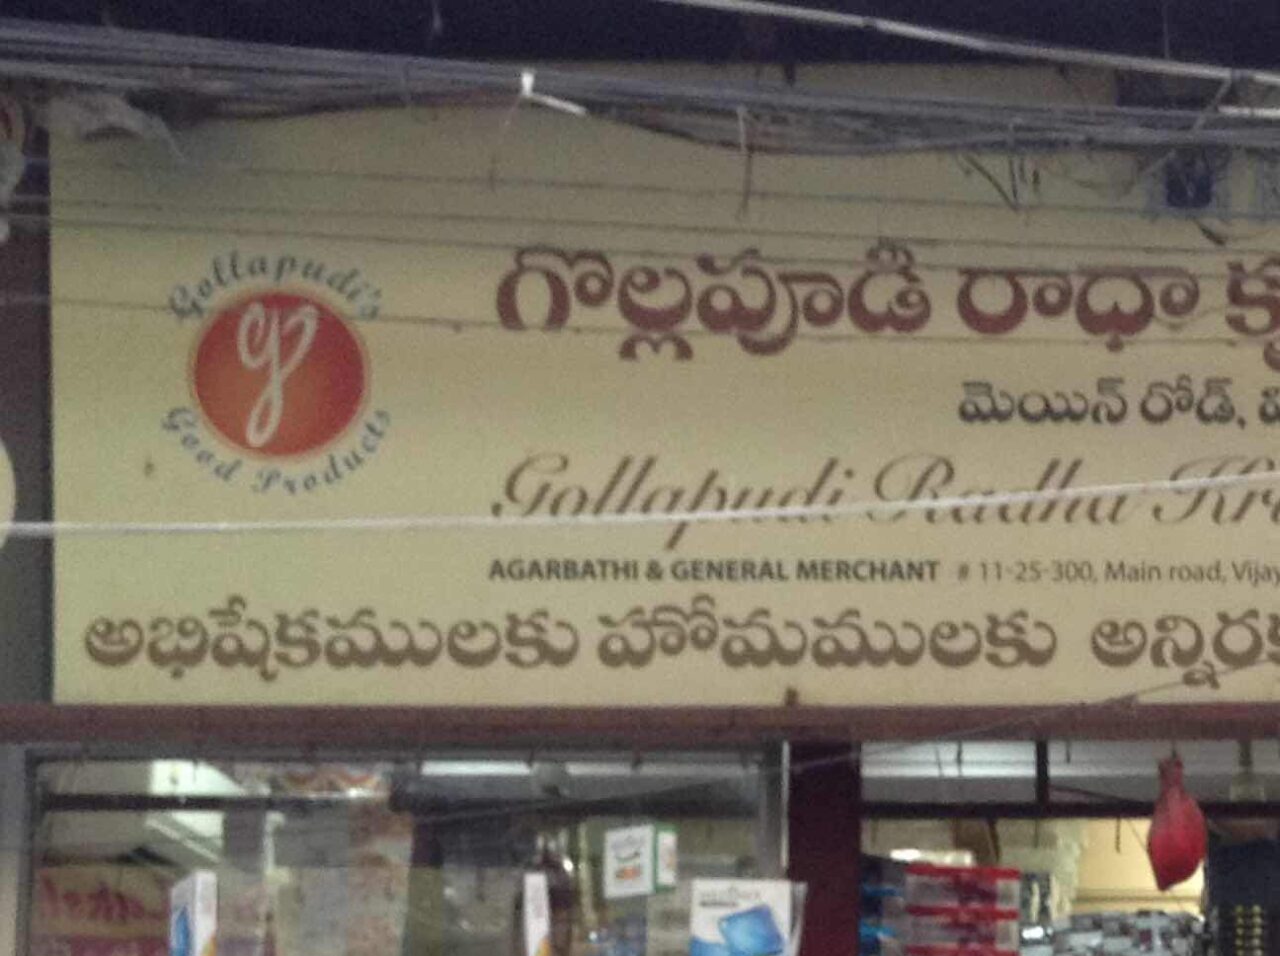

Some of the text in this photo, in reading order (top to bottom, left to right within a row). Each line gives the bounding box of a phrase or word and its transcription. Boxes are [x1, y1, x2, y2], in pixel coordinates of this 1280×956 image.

[957, 266, 1201, 352] రాధా
[491, 451, 855, 552] Gollapudi
[867, 453, 1135, 526] Radha
[489, 560, 638, 582] AGARBATHI
[645, 560, 664, 582] &
[671, 560, 789, 582] GENERAL
[797, 560, 940, 582] MERCHANT
[1104, 560, 1162, 582] Main
[1168, 560, 1226, 585] road,
[83, 594, 582, 684] అభిషేకములకు
[597, 594, 1058, 668] హోమములకు
